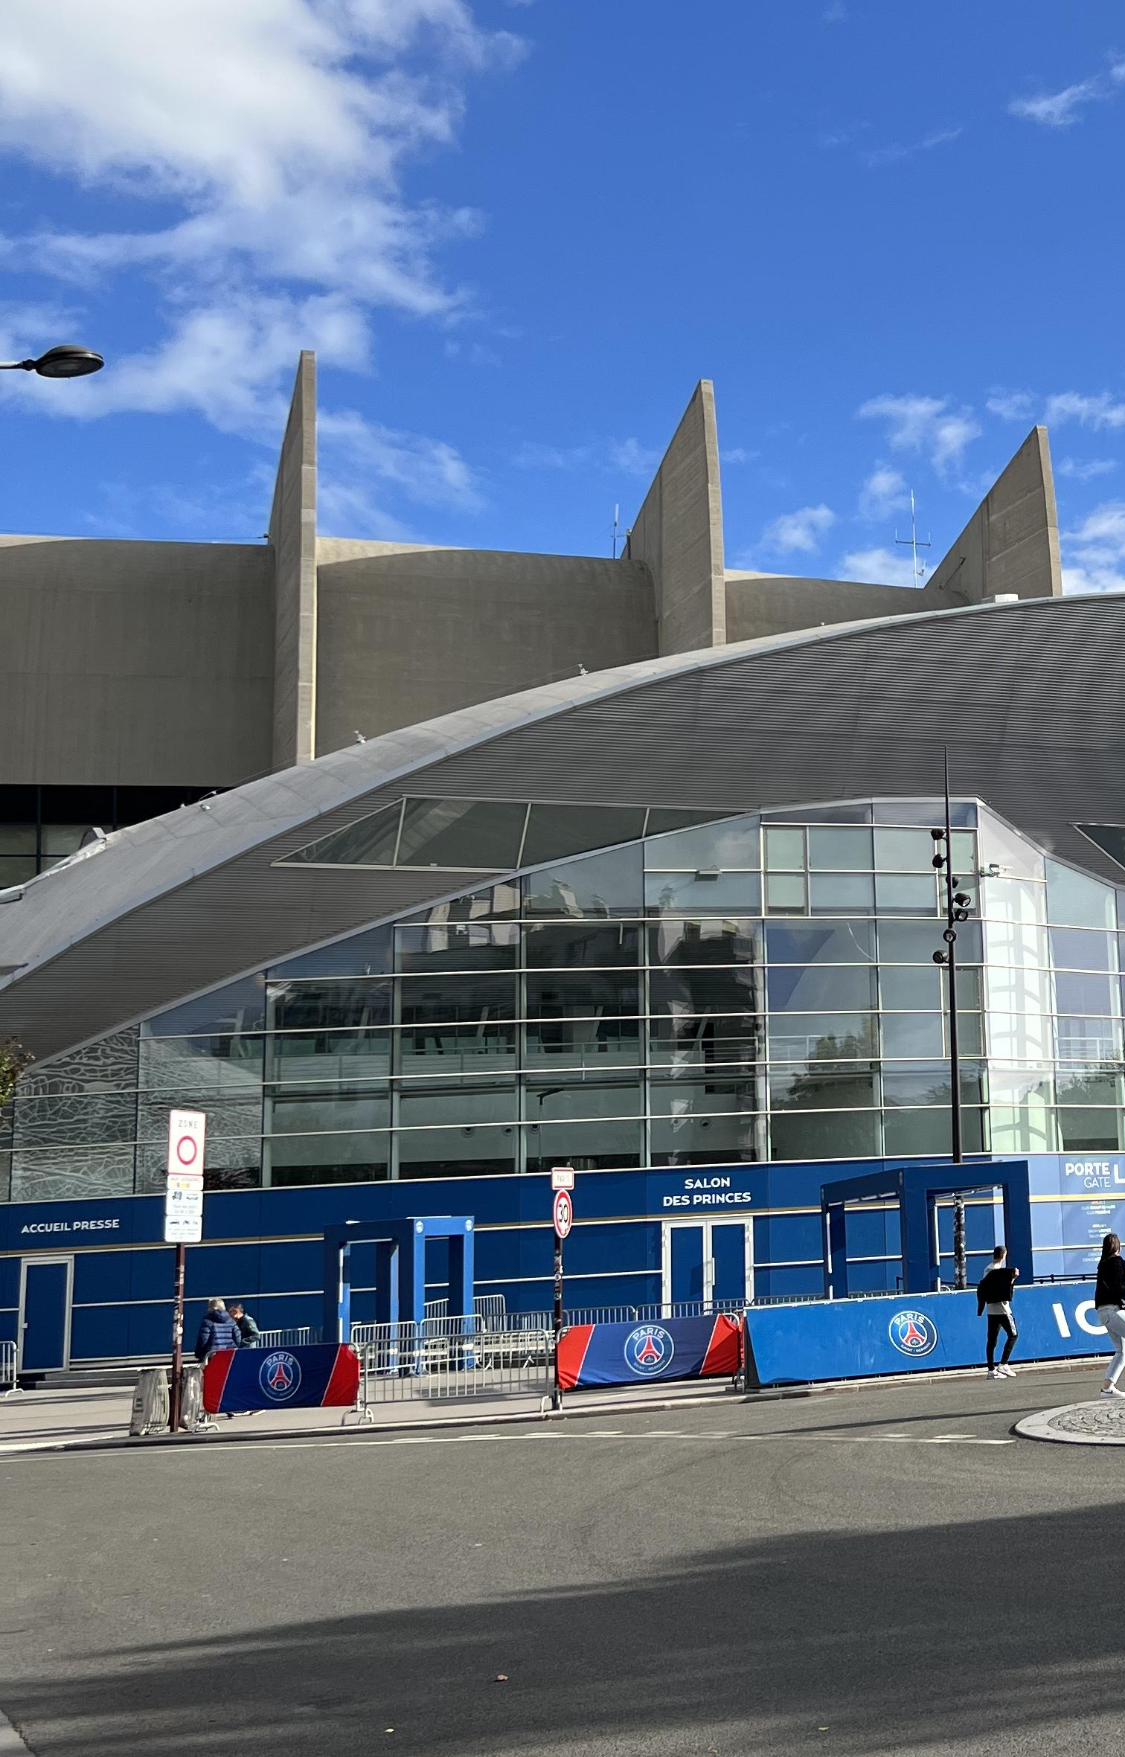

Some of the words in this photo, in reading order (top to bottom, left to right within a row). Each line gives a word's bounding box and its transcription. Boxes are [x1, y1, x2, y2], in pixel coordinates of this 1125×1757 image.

[178, 1119, 198, 1129] ZONE
[1065, 1162, 1111, 1176] PORTE
[684, 1177, 731, 1190] SALON
[1083, 1176, 1112, 1189] GATE
[663, 1195, 691, 1207] DES
[693, 1192, 752, 1205] PRINCES
[558, 1203, 569, 1223] 30
[21, 1222, 71, 1234] ACCUEIL
[73, 1219, 120, 1231] PRESSE
[893, 1313, 925, 1325] PARIS
[1052, 1299, 1109, 1339] IC
[631, 1327, 666, 1340] PARIS
[266, 1354, 293, 1366] PARIS
